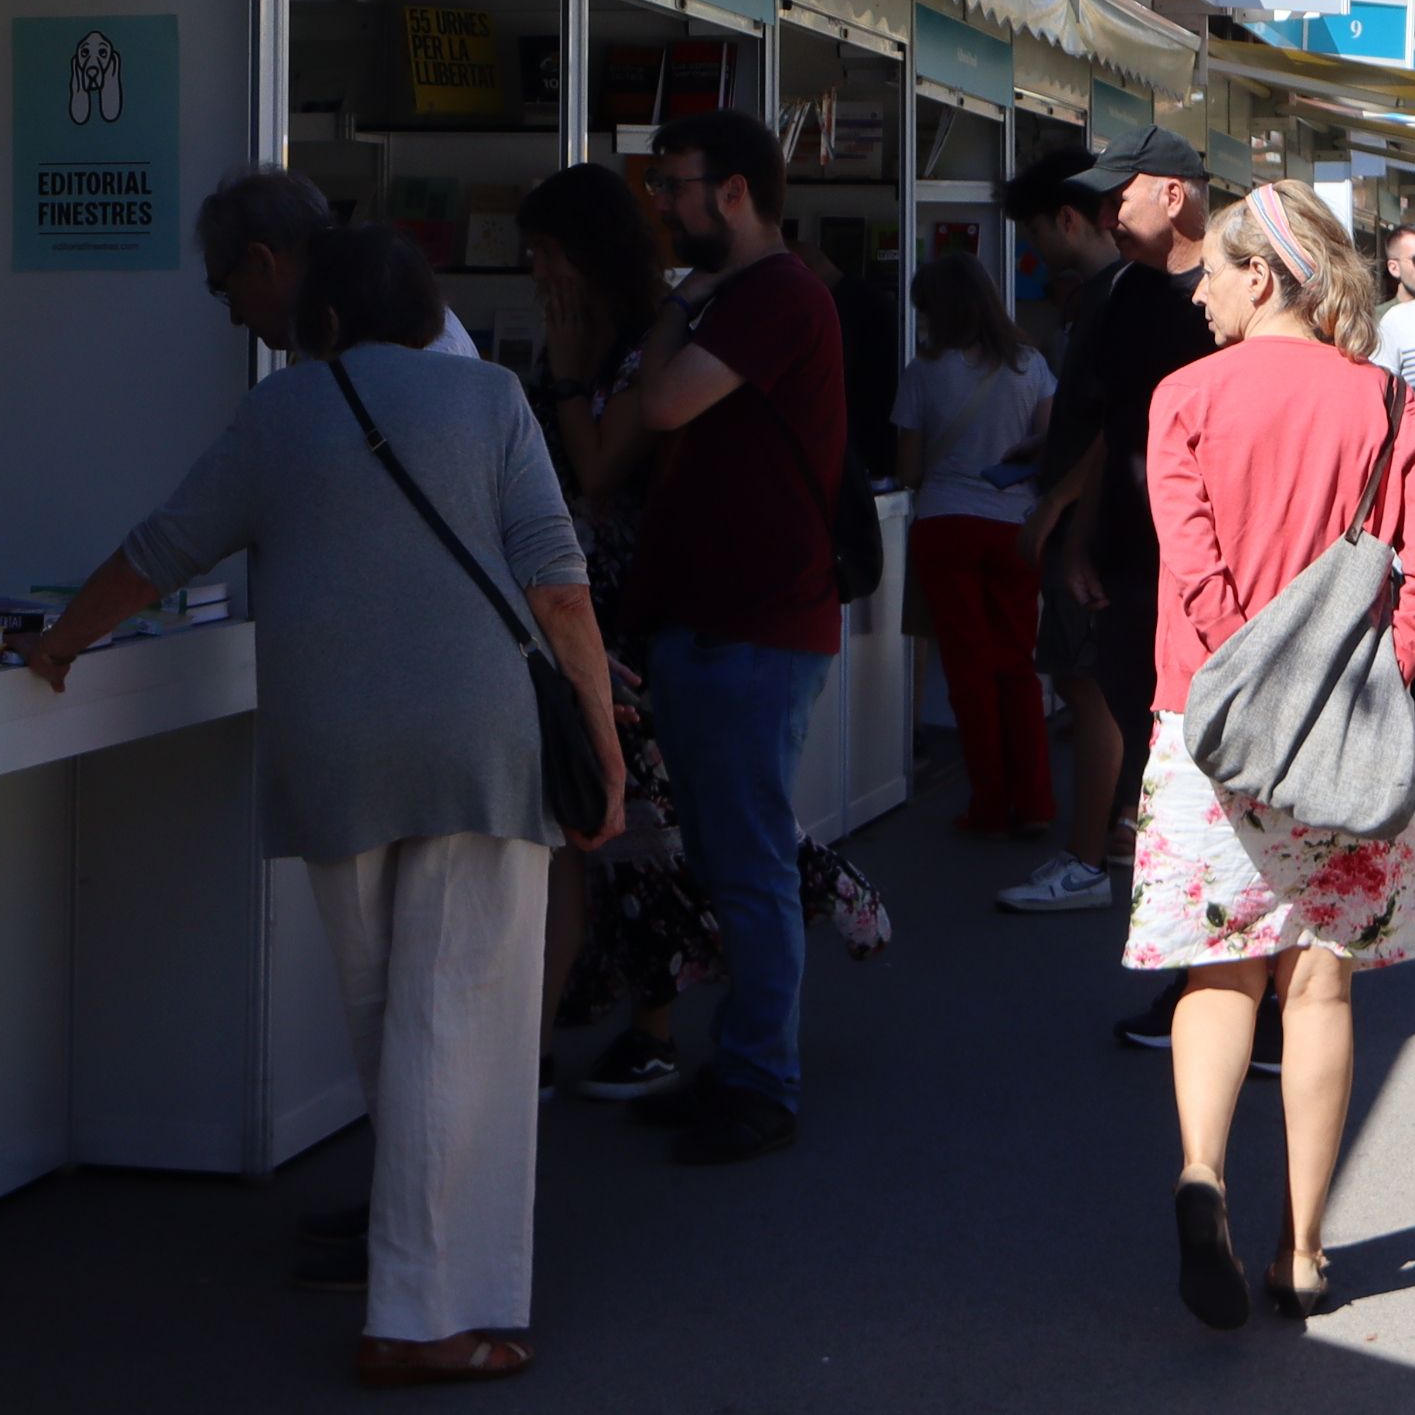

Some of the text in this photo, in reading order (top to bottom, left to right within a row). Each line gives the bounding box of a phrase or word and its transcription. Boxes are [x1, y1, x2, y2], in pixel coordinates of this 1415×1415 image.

[409, 8, 489, 37] 55 URNES
[1349, 19, 1362, 39] 9
[411, 34, 470, 61] PER LA
[415, 61, 496, 89] LLIBERTAT
[38, 170, 152, 196] EDITORIAL
[38, 201, 153, 226] FINESTRES
